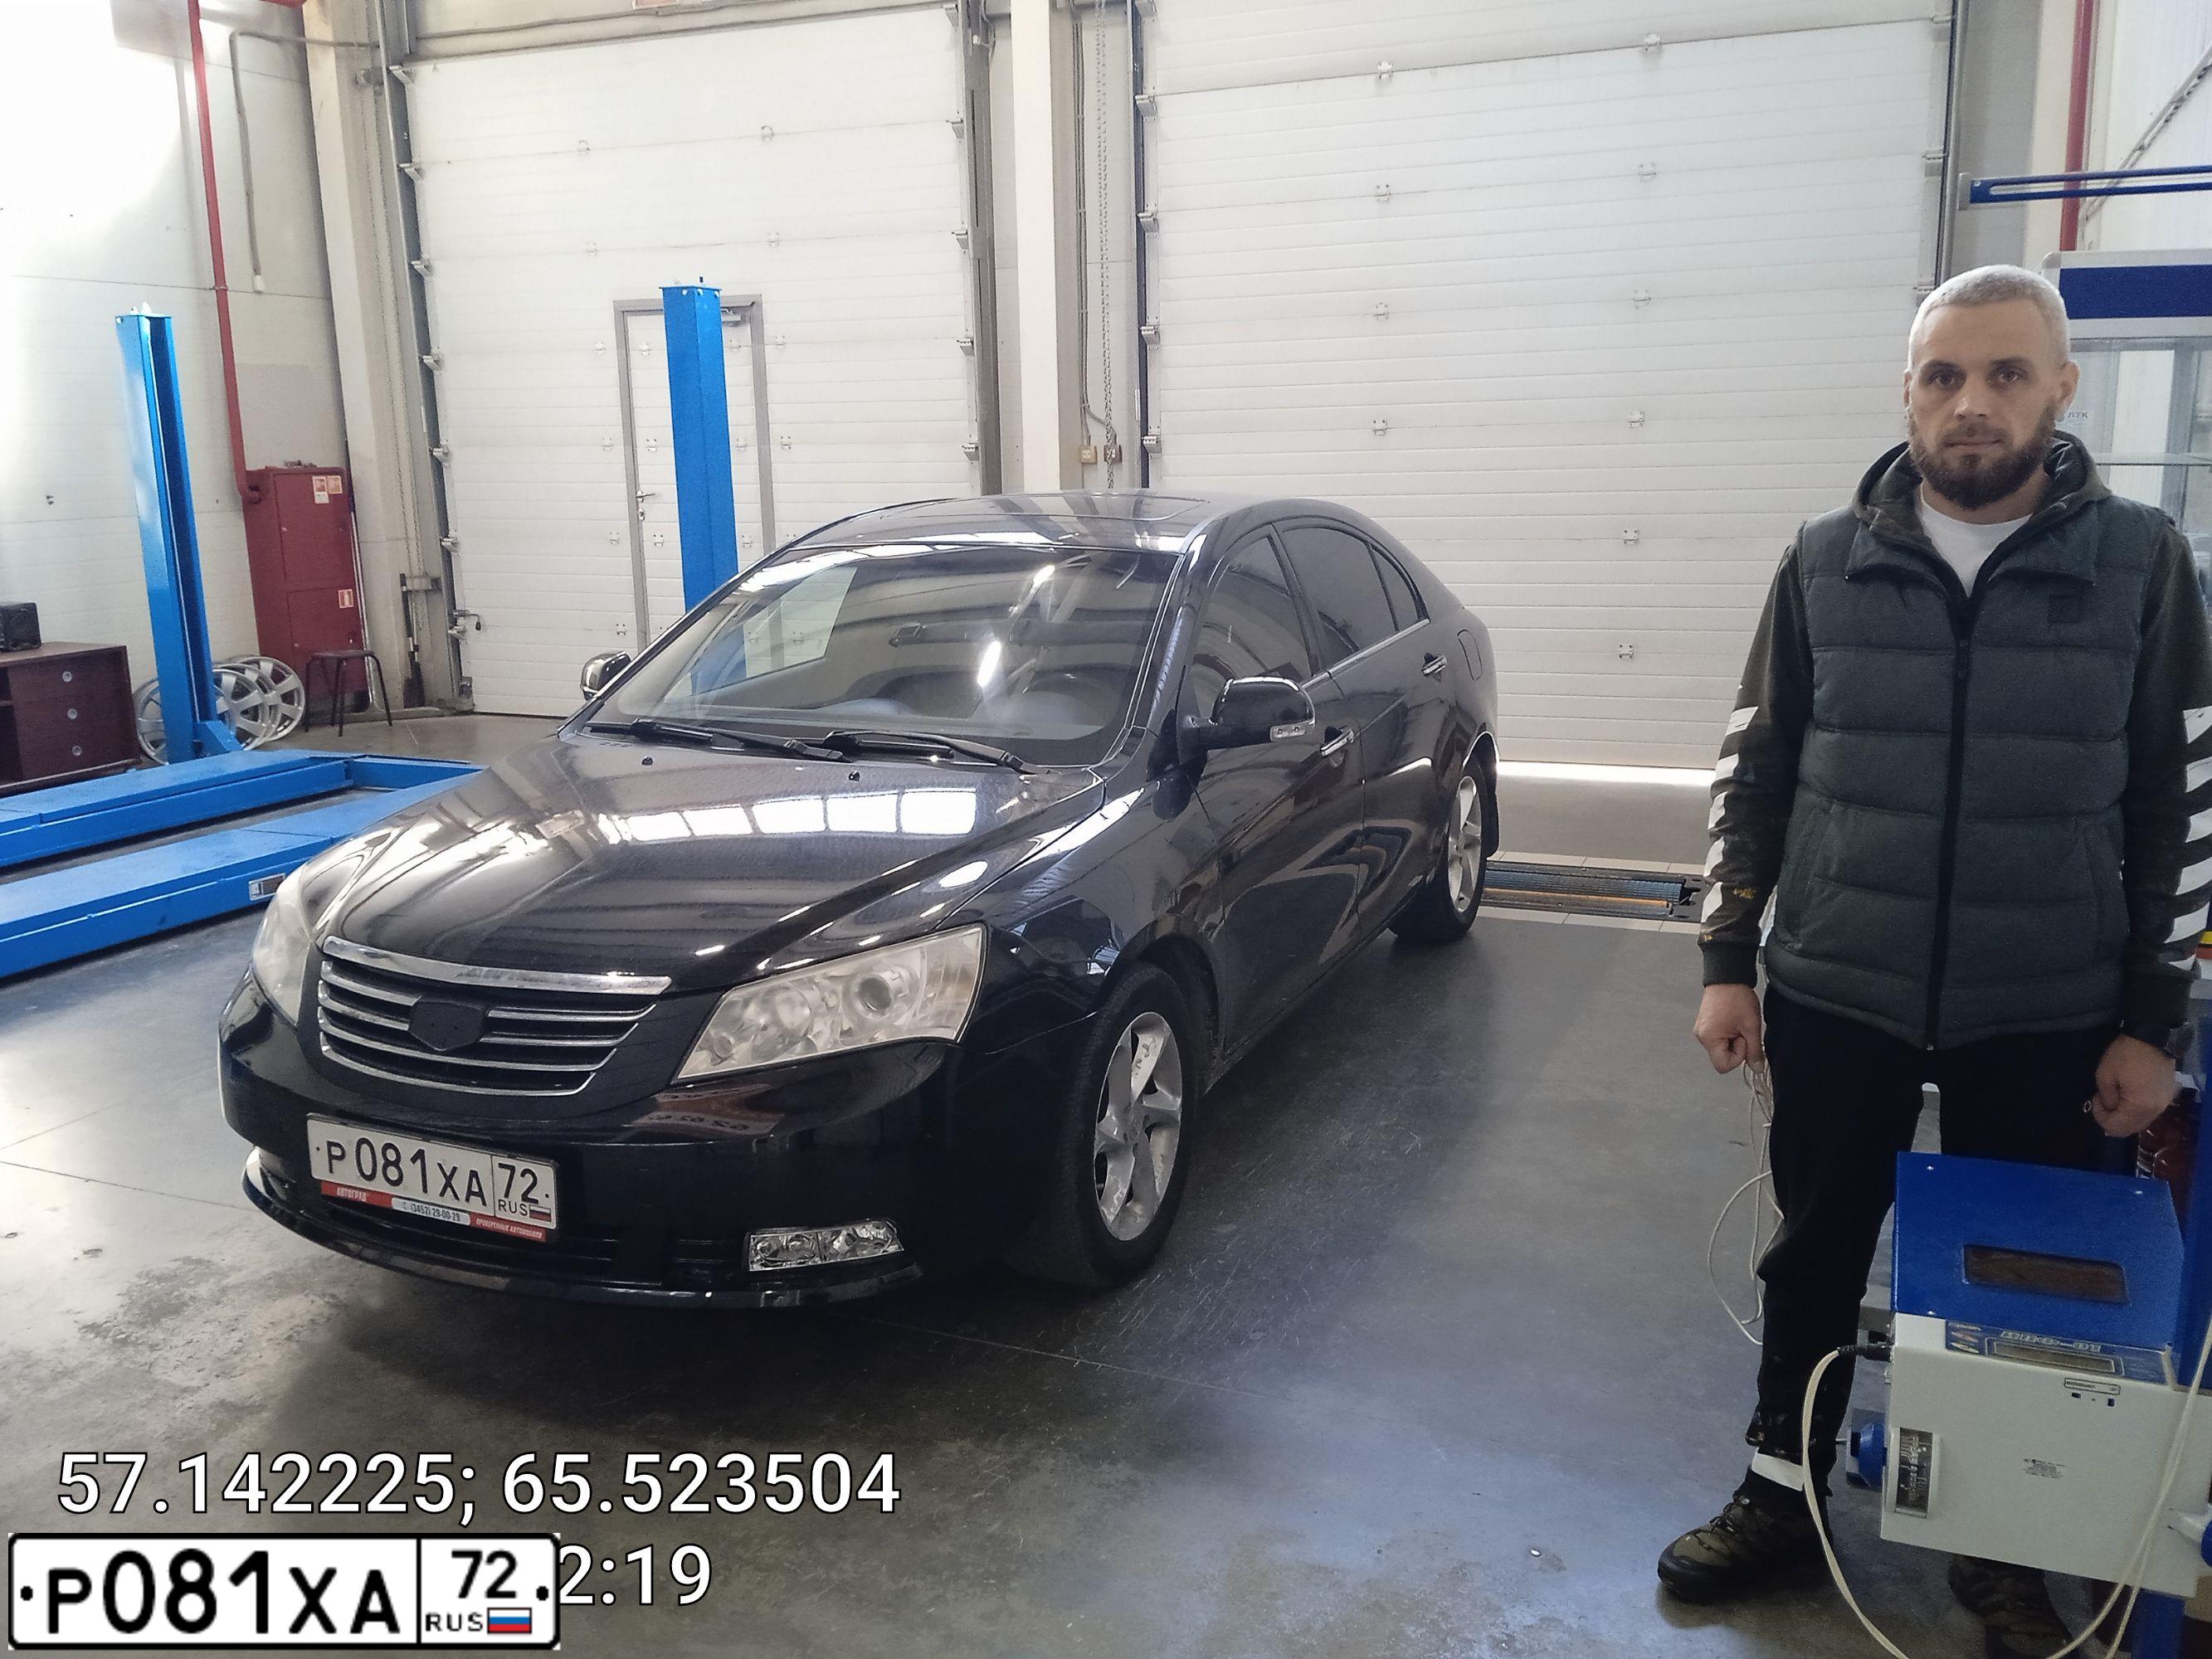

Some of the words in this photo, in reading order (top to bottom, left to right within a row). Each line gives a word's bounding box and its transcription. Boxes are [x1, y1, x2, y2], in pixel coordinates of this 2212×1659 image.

[325, 1136, 488, 1207] Р081ХА
[497, 1161, 539, 1204] 72
[336, 1186, 367, 1202] АВТОГРАД
[498, 1199, 529, 1216] RUS
